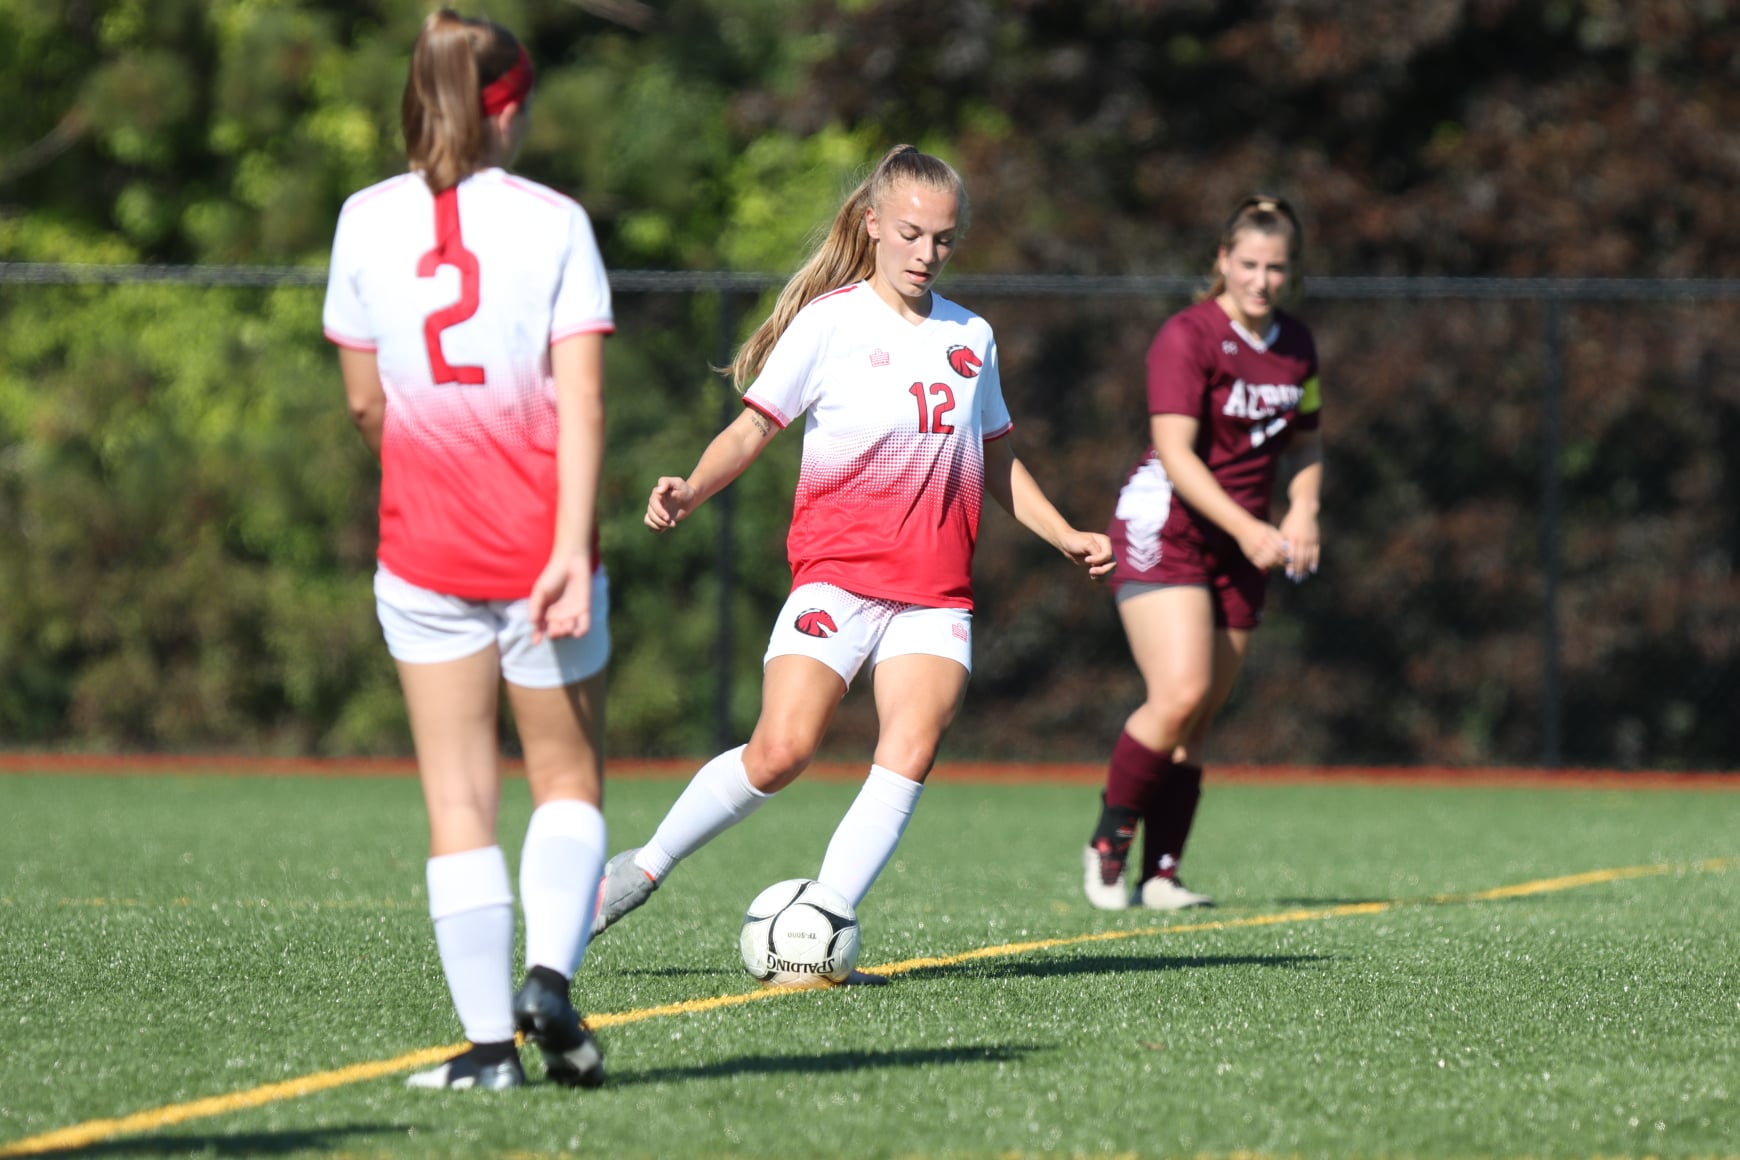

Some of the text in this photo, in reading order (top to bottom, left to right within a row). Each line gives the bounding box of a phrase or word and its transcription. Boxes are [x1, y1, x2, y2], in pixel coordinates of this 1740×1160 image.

[416, 247, 485, 385] 2
[909, 382, 955, 435] 12
[766, 954, 835, 974] SPALDING
